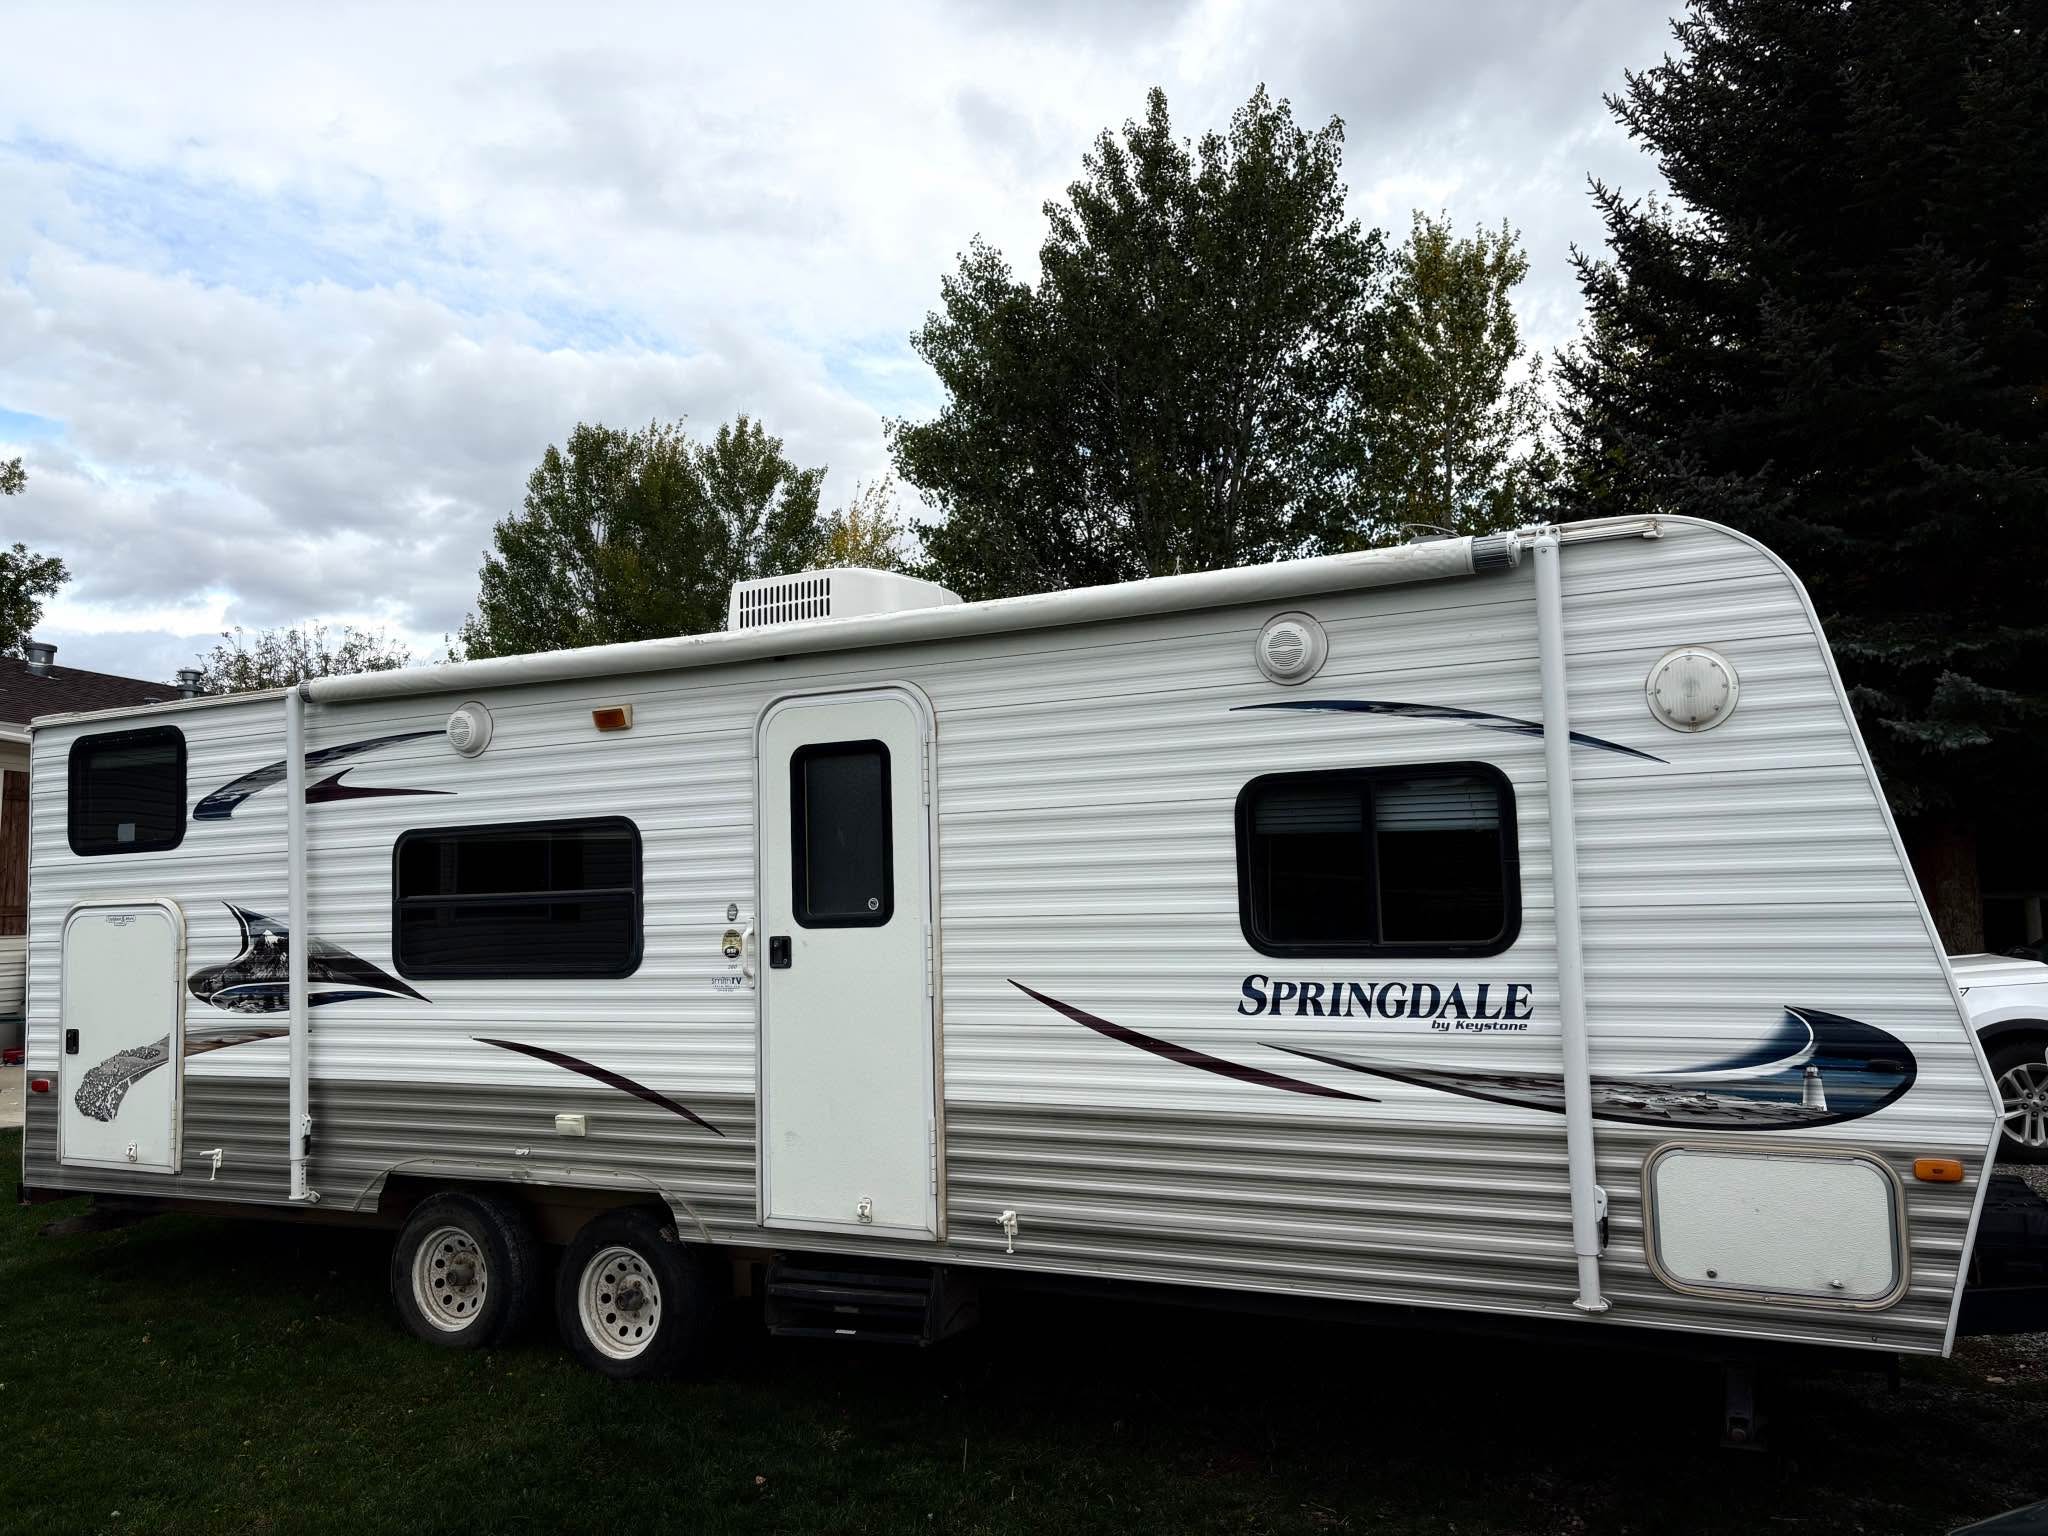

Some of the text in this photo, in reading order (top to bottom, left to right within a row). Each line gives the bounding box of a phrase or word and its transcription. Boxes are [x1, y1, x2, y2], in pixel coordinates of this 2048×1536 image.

[1237, 973, 1534, 1020] SPRINGDALE
[1431, 1020, 1528, 1032] by Keystone
